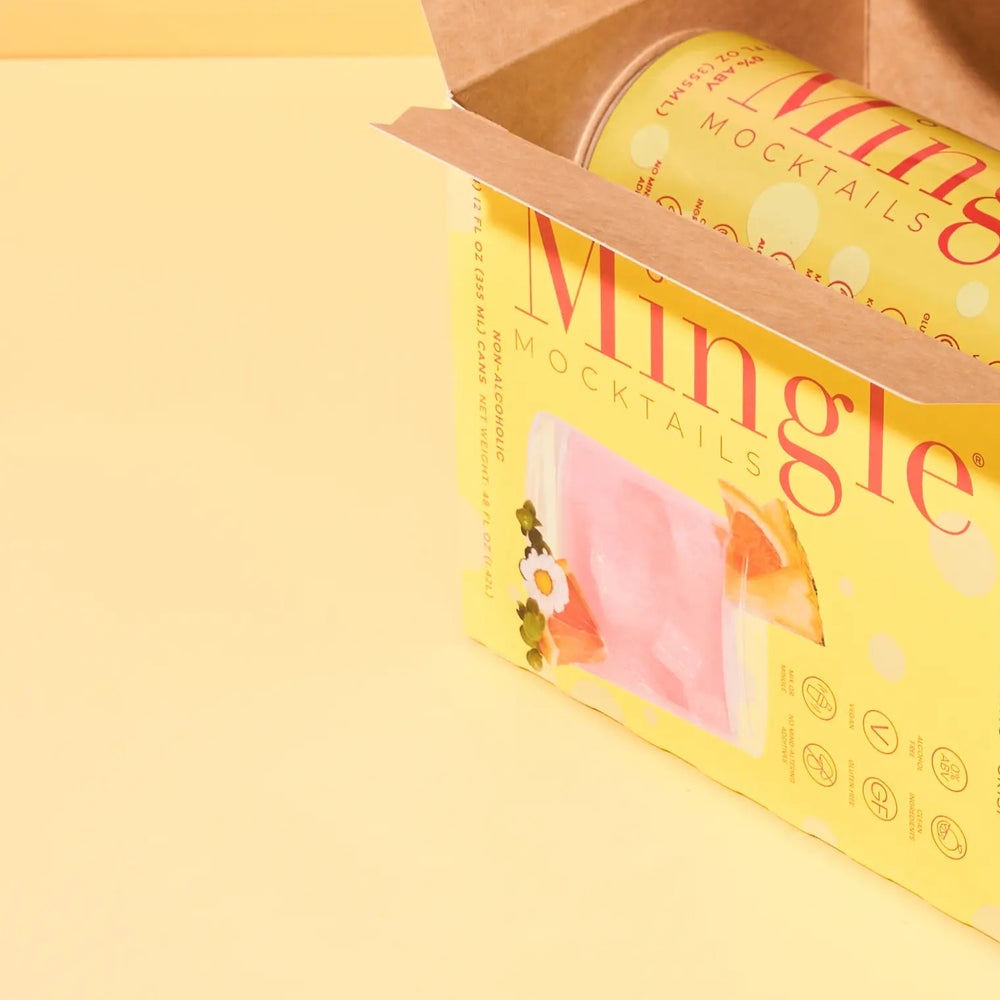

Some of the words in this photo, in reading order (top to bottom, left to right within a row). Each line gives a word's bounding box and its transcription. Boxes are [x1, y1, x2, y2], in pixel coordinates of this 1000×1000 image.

[655, 62, 715, 117] (355ML)
[705, 66, 736, 92] ABV
[652, 160, 662, 176] NO
[700, 111, 930, 234] MOCKTAILS
[473, 215, 483, 234] FL
[474, 240, 484, 263] OZ
[474, 267, 485, 301] (355
[475, 305, 487, 336] ML)
[477, 341, 487, 386] CANS
[478, 393, 488, 424] NET
[492, 329, 506, 463] NON-ALCOHOLIC
[514, 327, 763, 478] MOCKTAILS
[869, 781, 889, 819] GF
